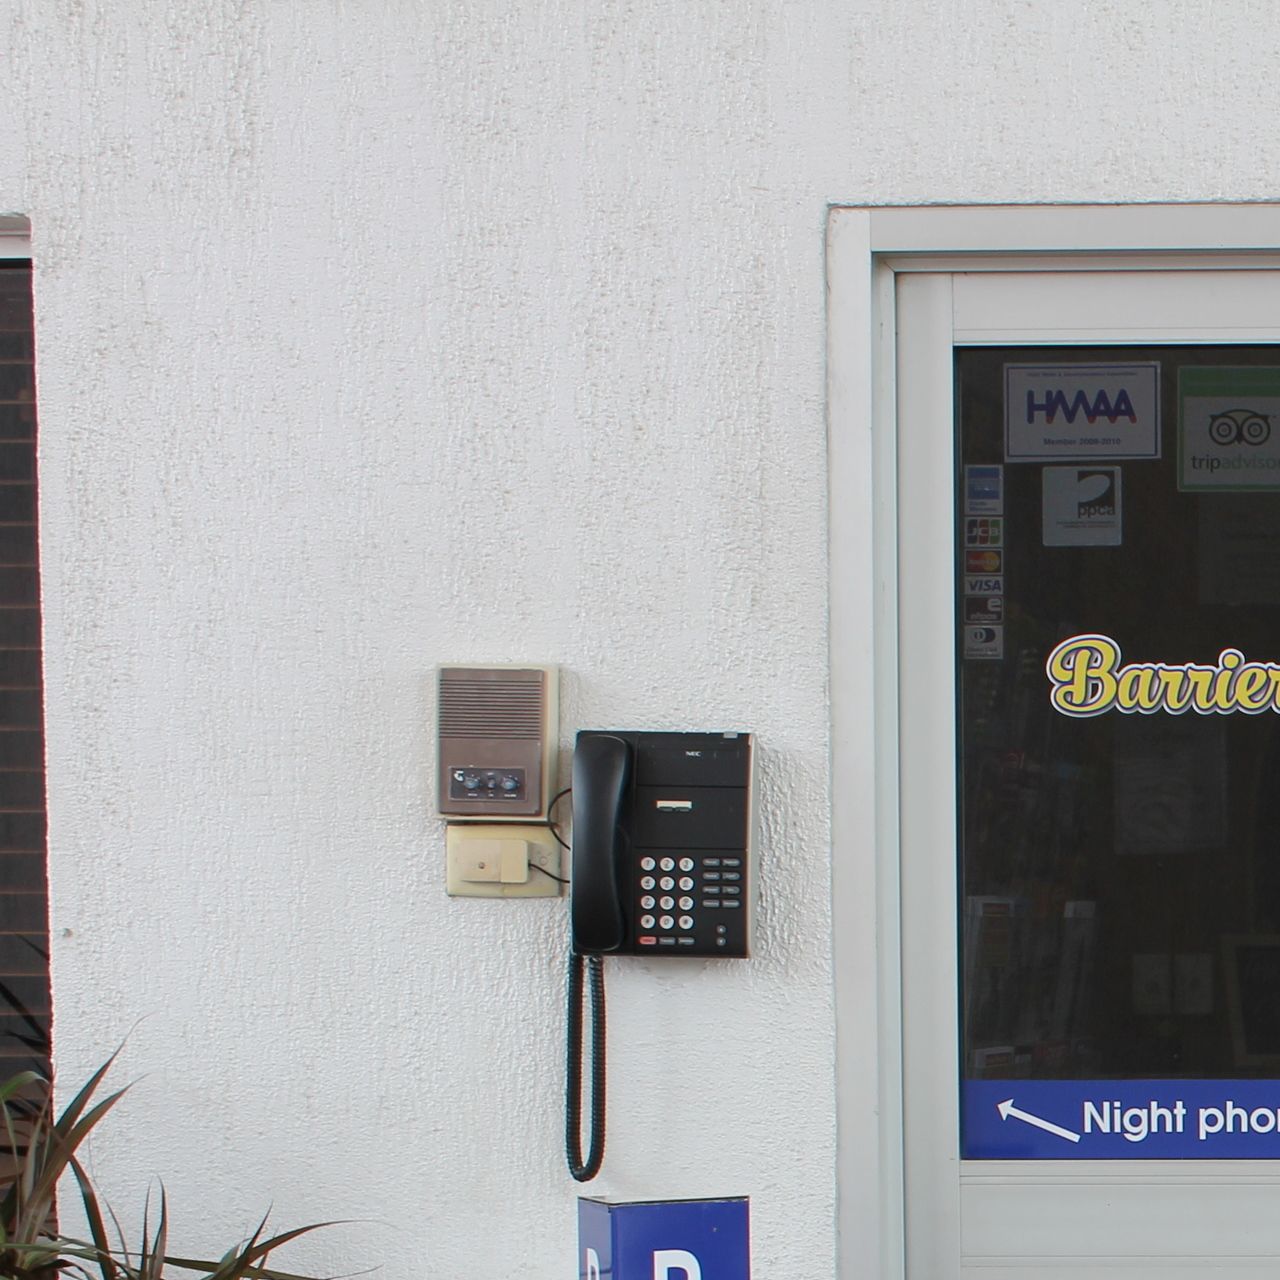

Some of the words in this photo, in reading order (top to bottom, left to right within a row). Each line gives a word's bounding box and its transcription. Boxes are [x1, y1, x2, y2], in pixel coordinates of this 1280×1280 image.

[1026, 389, 1137, 424] HMAA
[1043, 437, 1077, 446] Member
[967, 527, 1000, 536] JCB
[968, 579, 1002, 592] VISA
[1083, 1100, 1187, 1142] Night
